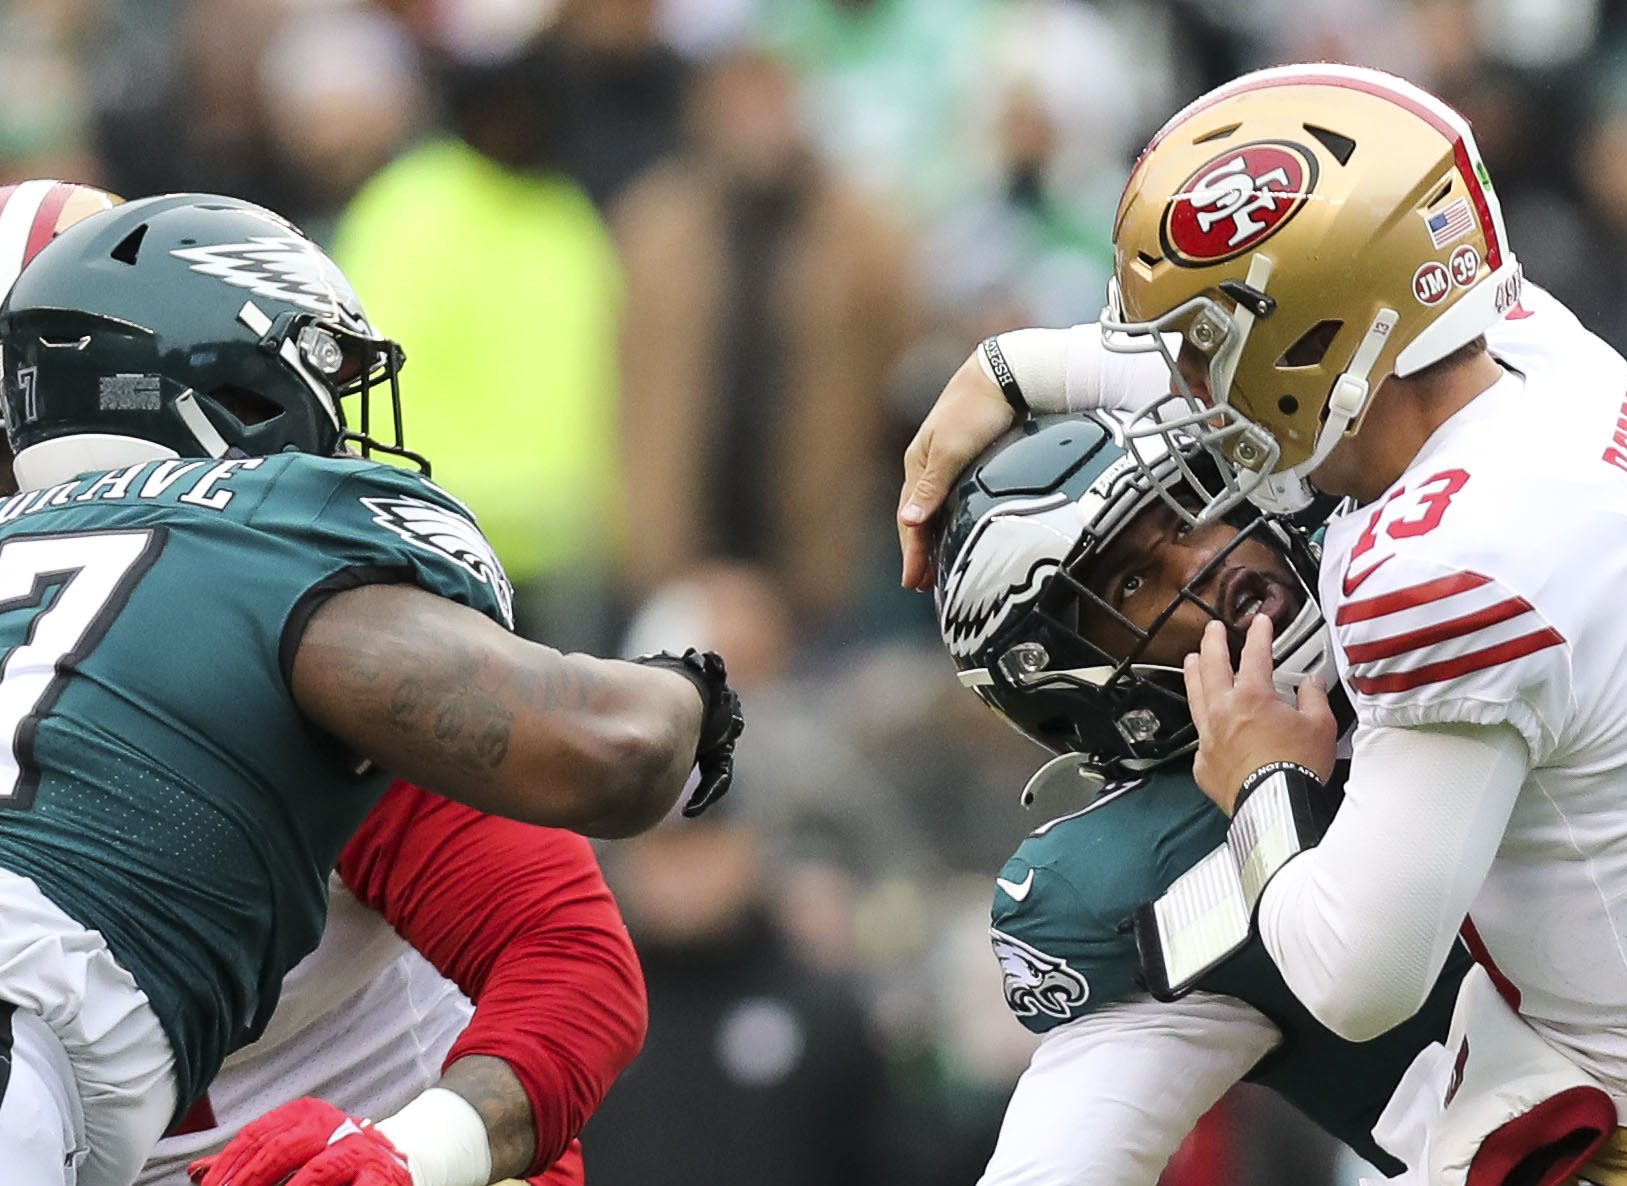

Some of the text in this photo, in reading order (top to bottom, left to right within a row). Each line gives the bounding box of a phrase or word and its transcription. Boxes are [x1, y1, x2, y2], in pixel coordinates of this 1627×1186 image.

[1453, 250, 1479, 282] 39
[1418, 269, 1447, 300] JM
[1350, 467, 1471, 563] 13
[1257, 762, 1280, 776] NOT
